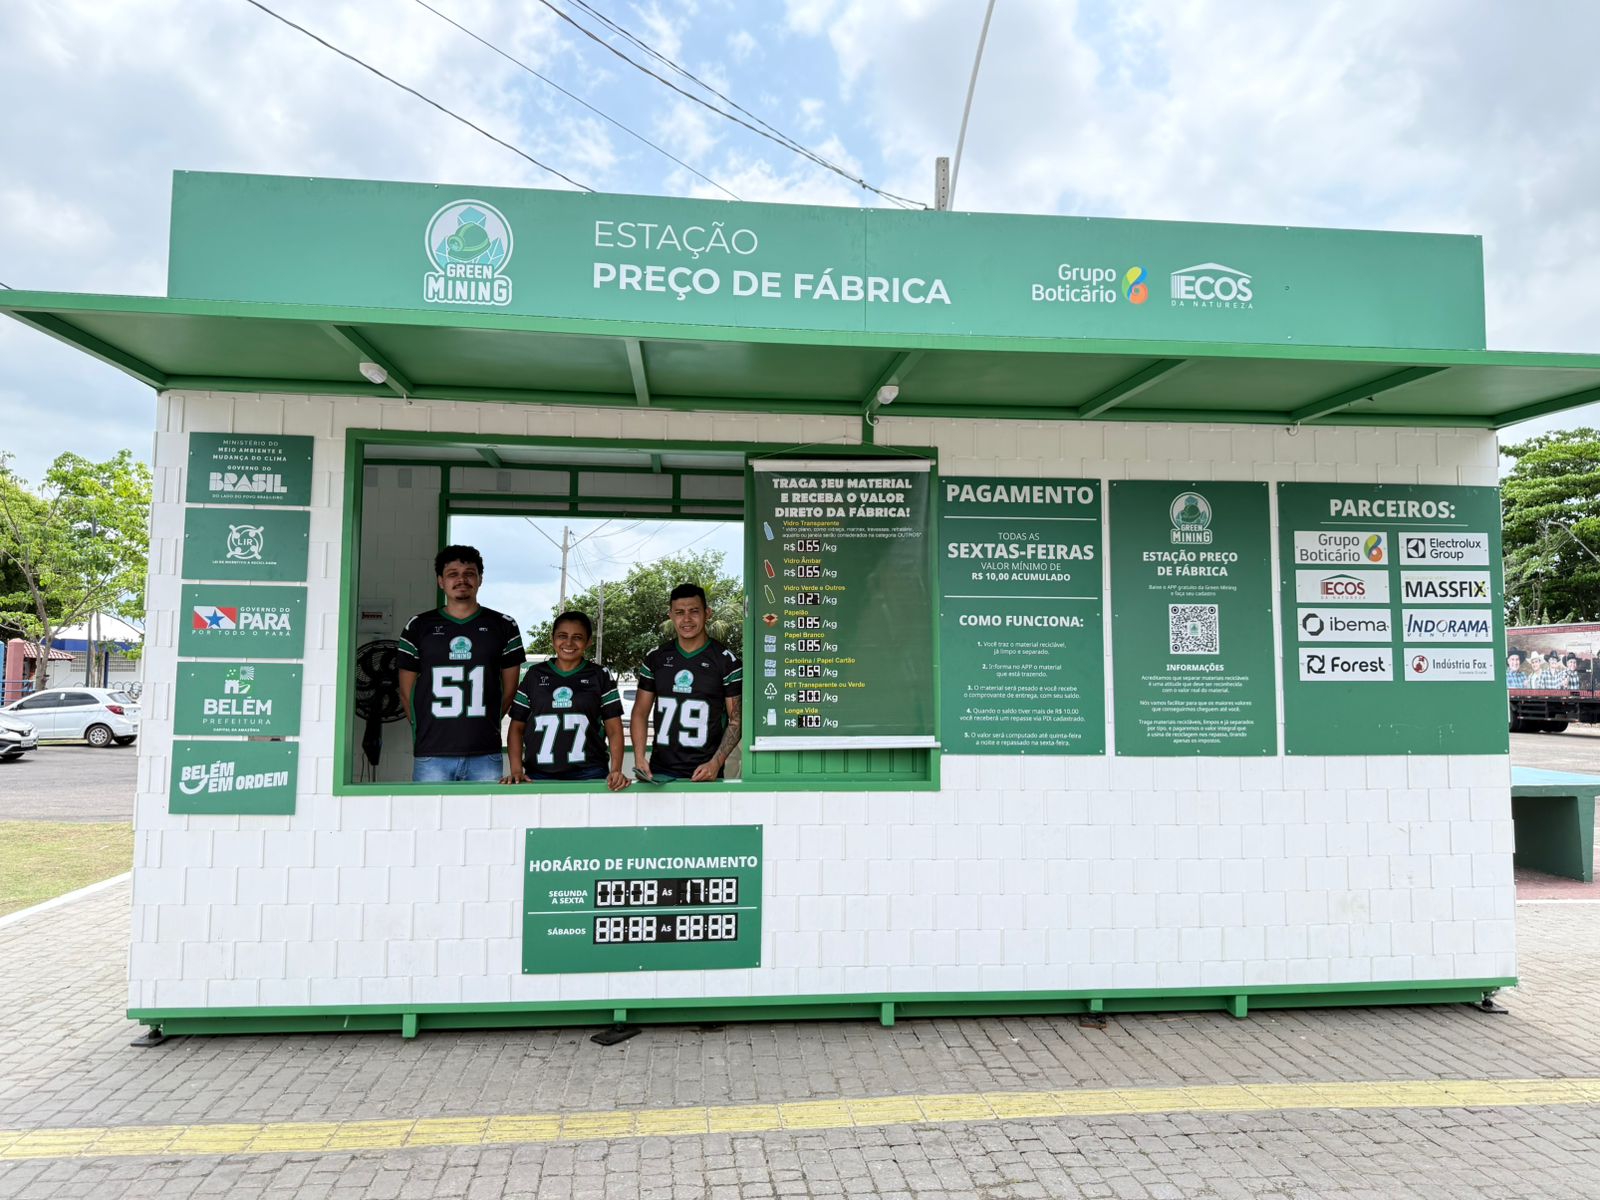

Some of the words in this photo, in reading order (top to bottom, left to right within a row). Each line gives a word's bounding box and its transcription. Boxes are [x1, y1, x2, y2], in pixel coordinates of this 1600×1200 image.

[595, 220, 758, 259] ESTAÇÃO
[445, 263, 494, 279] GREEN
[1058, 263, 1117, 286] Grupo
[426, 276, 508, 302] MINING
[594, 263, 719, 300] PREÇO
[733, 270, 781, 298] DE
[795, 267, 952, 304] FÁBRICA
[1171, 275, 1253, 301] ECOS
[1032, 284, 1117, 303] Boticário
[1193, 301, 1254, 309] NATUREZA
[223, 438, 266, 446] MINISTÉRIO
[209, 472, 287, 493] BRASIL
[772, 478, 818, 489] TRAGA
[821, 478, 845, 489] SEU
[847, 478, 912, 489] MATERIAL
[781, 493, 789, 503] E
[792, 493, 844, 503] RECEBA
[846, 493, 857, 503] O
[860, 493, 904, 503] VALOR
[947, 484, 1094, 504] PAGAMENTO
[775, 507, 823, 518] DIRETO
[827, 507, 846, 518] DA
[849, 504, 910, 518] FÁBRICA!
[1330, 499, 1456, 519] PARCEIROS:
[1172, 531, 1211, 543] MINING
[1318, 533, 1359, 548] Grupo
[1430, 538, 1481, 548] Electrolux
[784, 543, 795, 552] R$
[822, 543, 837, 552] /kg
[948, 543, 1094, 560] SEXTAS-FEIRAS
[1143, 550, 1196, 564] ESTAÇÃO
[1200, 552, 1238, 564] PREÇO
[1300, 549, 1360, 562] Boticário
[1430, 550, 1464, 560] Group
[981, 562, 1009, 570] VALOR
[1012, 561, 1047, 570] MÍNIMO
[1157, 566, 1172, 576] DE
[1176, 564, 1228, 576] FÁBRICA
[784, 569, 796, 577] R$
[822, 568, 837, 578] /kg
[972, 572, 983, 581] R$
[986, 573, 1009, 582] 10,00
[1012, 573, 1071, 581] ACUMULADO
[1321, 582, 1365, 595] ECOS
[1405, 581, 1486, 597] MASSFIX
[784, 596, 796, 604] R$
[822, 596, 837, 606] /kg
[240, 612, 291, 630] PARÁ
[784, 620, 795, 628] R$
[822, 620, 837, 629] /kg
[959, 615, 1002, 626] COMO
[1006, 616, 1084, 627] FUNCIONA:
[1330, 617, 1387, 631] ibema
[1408, 614, 1488, 632] INDORAMA
[784, 643, 796, 651] R$
[822, 643, 838, 652] /kg
[1166, 663, 1224, 672] INFORMAÇÕES
[1331, 657, 1385, 672] Forest
[1433, 659, 1470, 669] Indústria
[1473, 659, 1487, 669] Fox
[823, 668, 838, 678] /kg
[431, 666, 486, 718] 51
[823, 693, 838, 703] /kg
[204, 696, 272, 715] BELÉM
[656, 696, 710, 747] 79
[823, 718, 838, 728] /kg
[535, 714, 589, 764] 77
[182, 760, 234, 782] BELÉM
[208, 777, 232, 793] EM
[236, 771, 288, 790] ORDEM
[529, 856, 600, 872] HORÁRIO
[605, 858, 622, 870] DE
[627, 856, 758, 870] FUNCIONAMENTO
[548, 927, 586, 936] SÁBADOS
